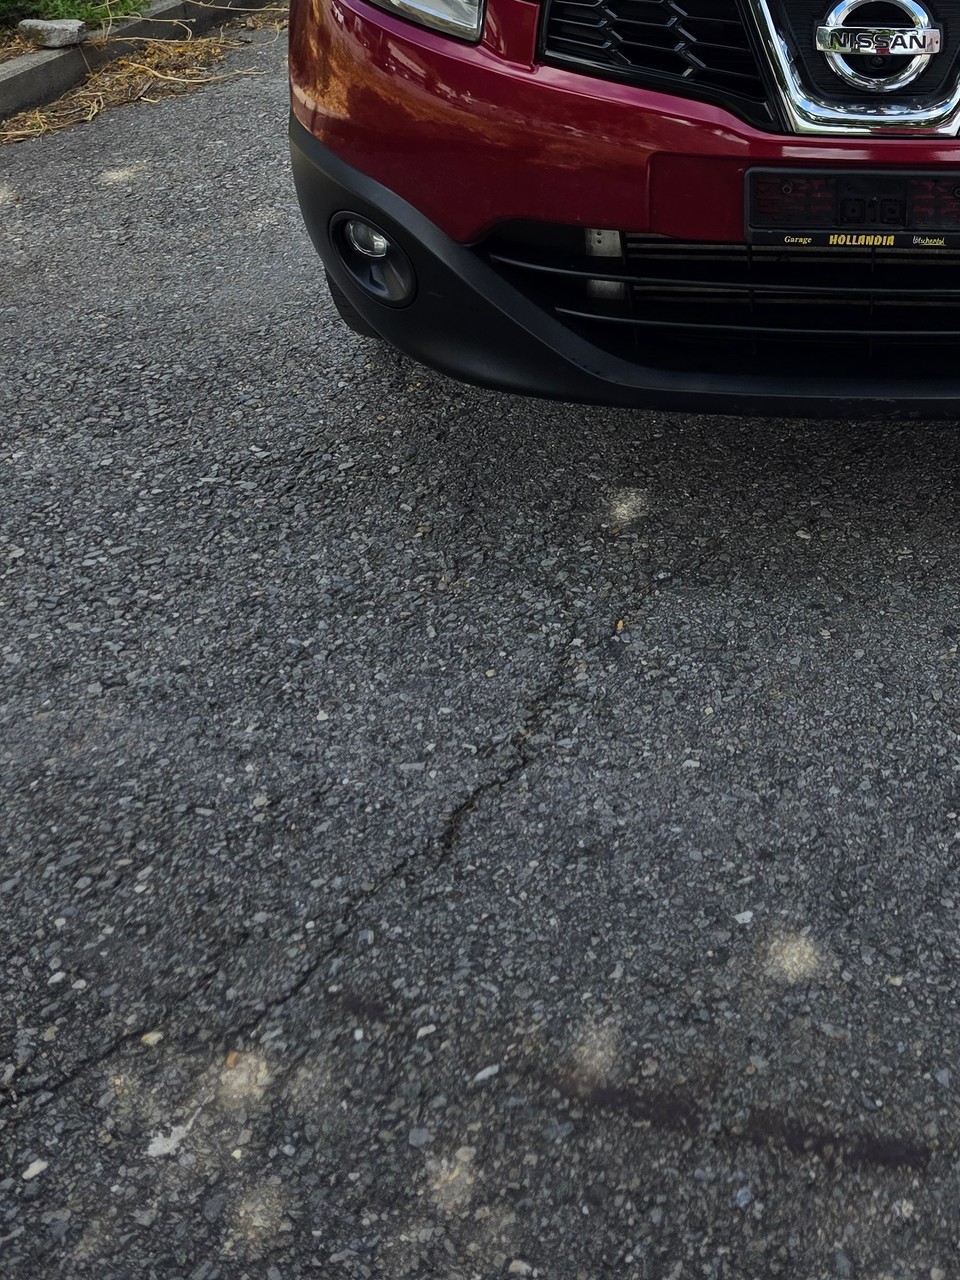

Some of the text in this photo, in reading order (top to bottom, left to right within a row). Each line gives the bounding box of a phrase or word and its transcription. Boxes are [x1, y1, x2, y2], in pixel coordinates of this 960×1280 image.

[830, 31, 926, 50] NISSAN
[784, 235, 812, 244] Garage
[829, 234, 895, 246] HOLLANDIA
